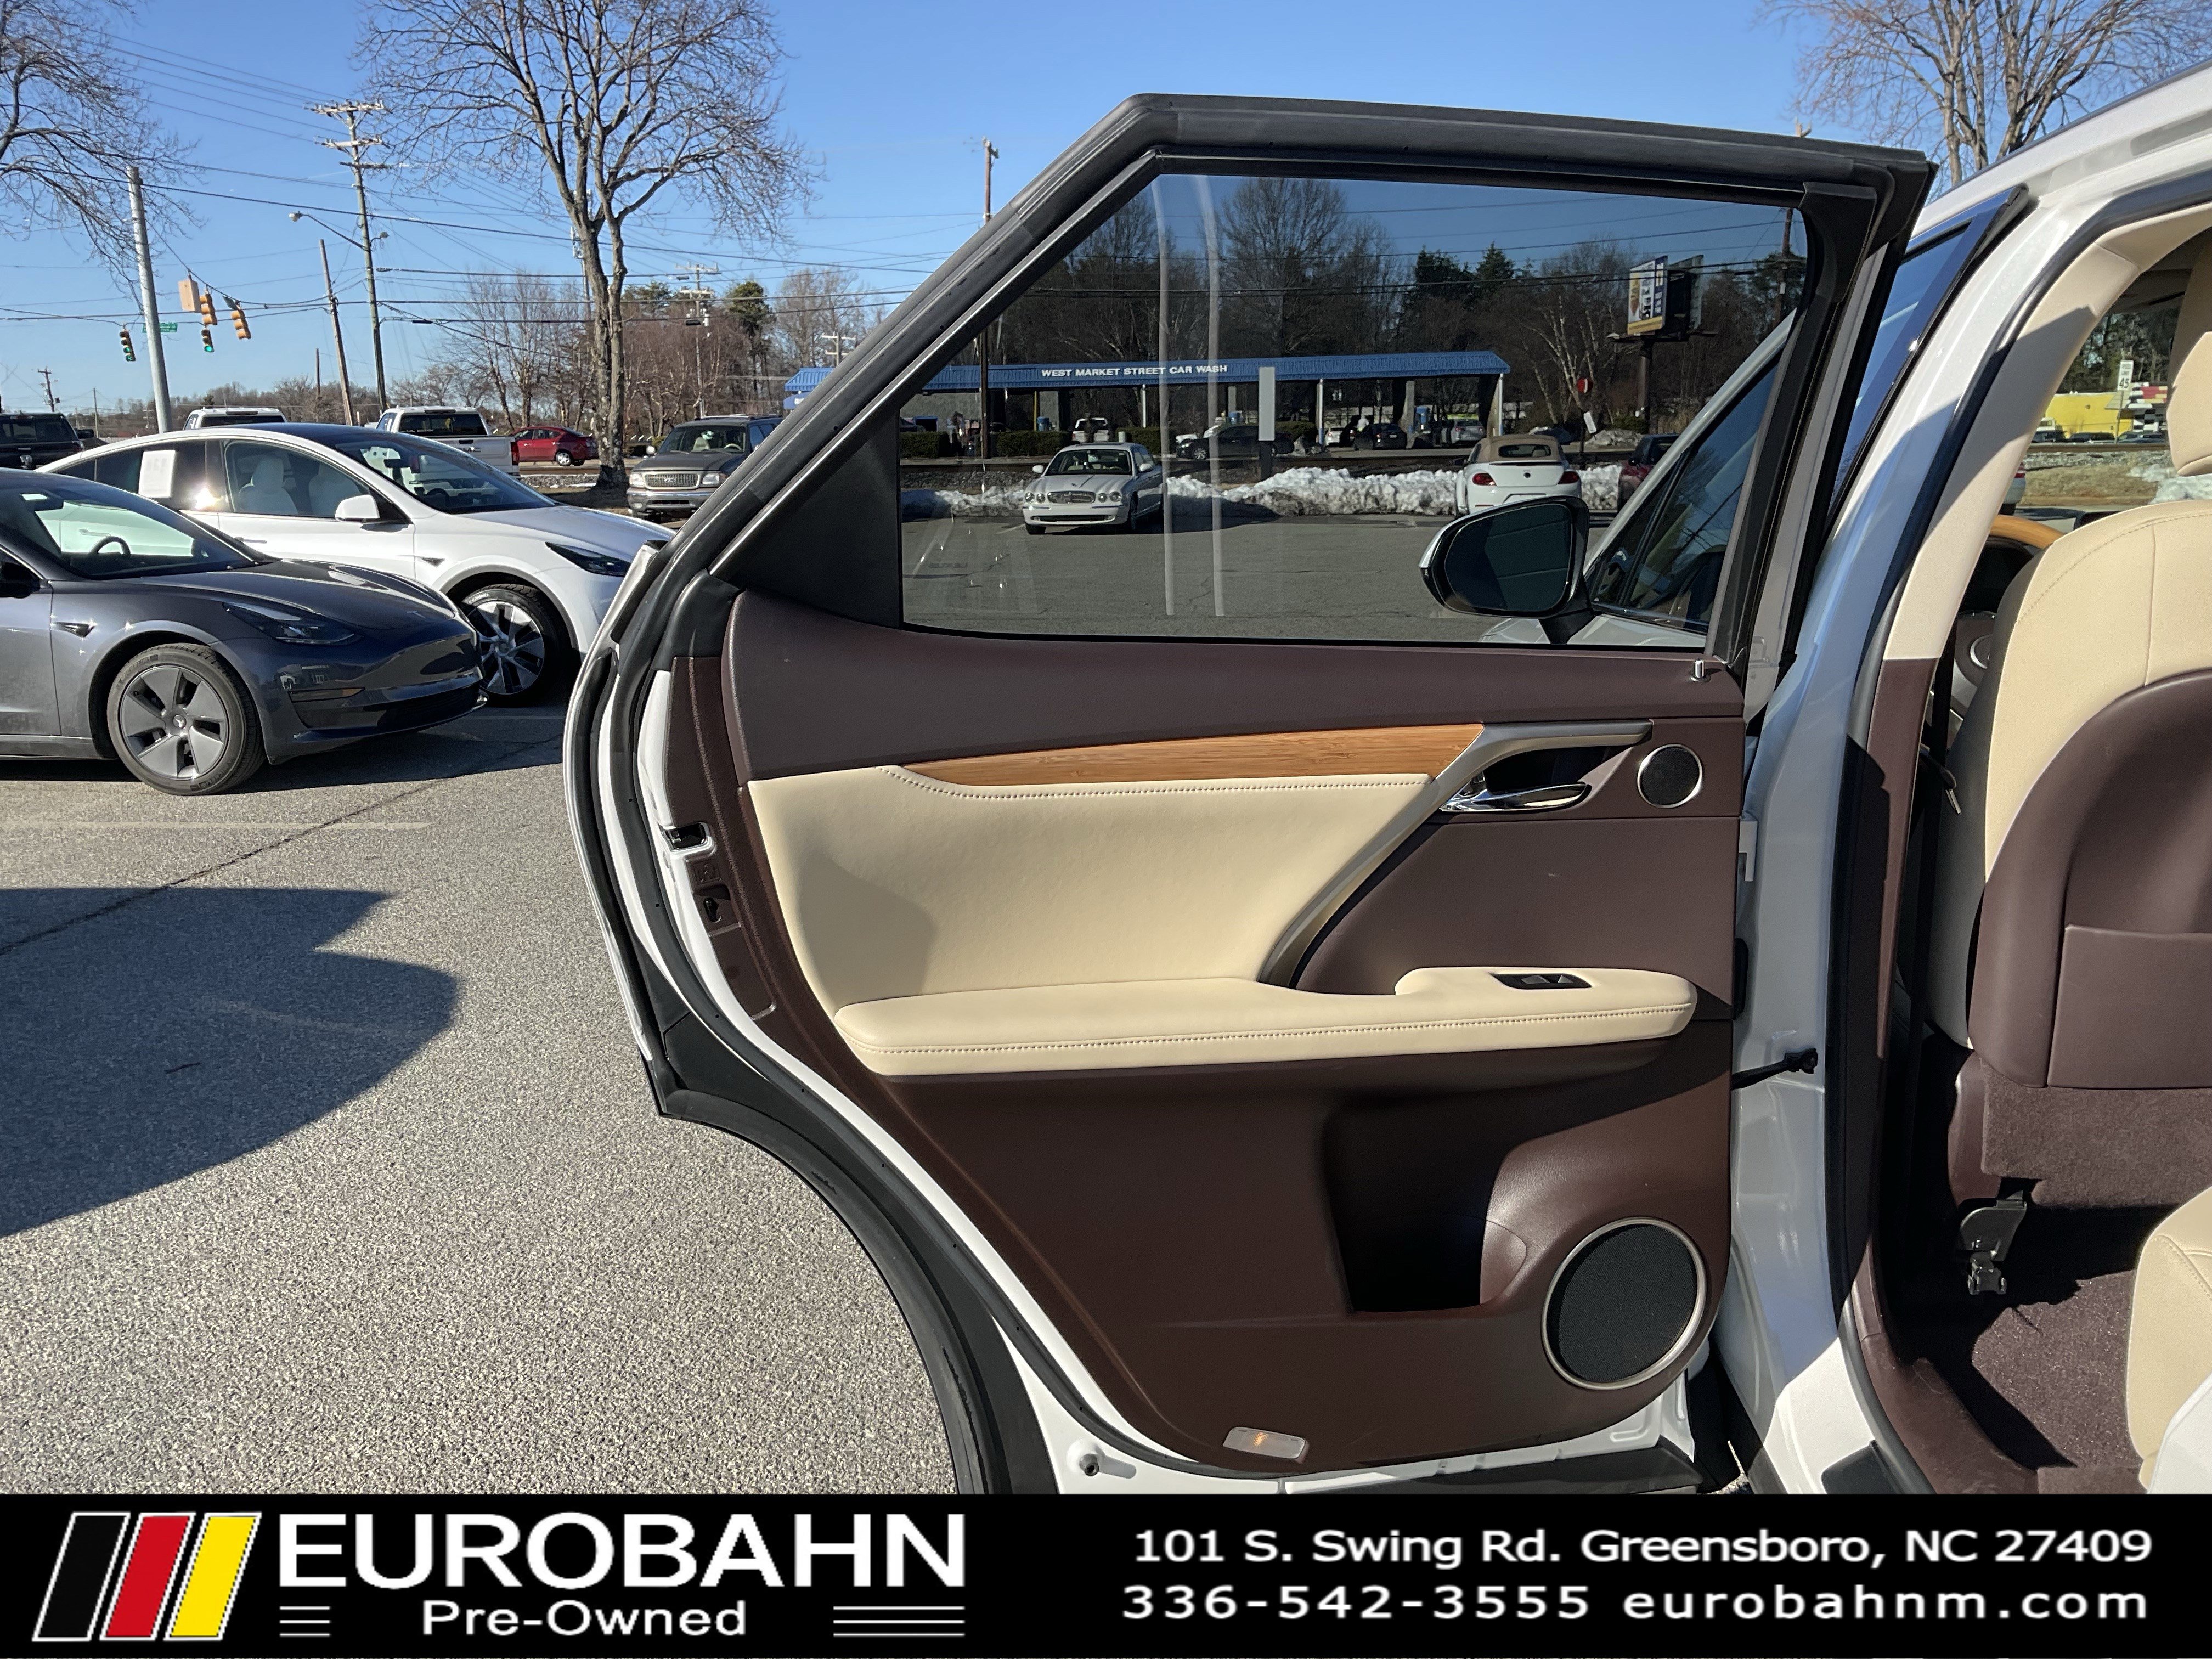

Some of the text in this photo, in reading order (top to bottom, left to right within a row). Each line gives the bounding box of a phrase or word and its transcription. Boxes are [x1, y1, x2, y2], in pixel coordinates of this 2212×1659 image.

[1075, 368, 1121, 377] MARKET
[1123, 367, 1166, 375] STREET
[1196, 365, 1228, 373] WASH
[2119, 377, 2129, 388] 45
